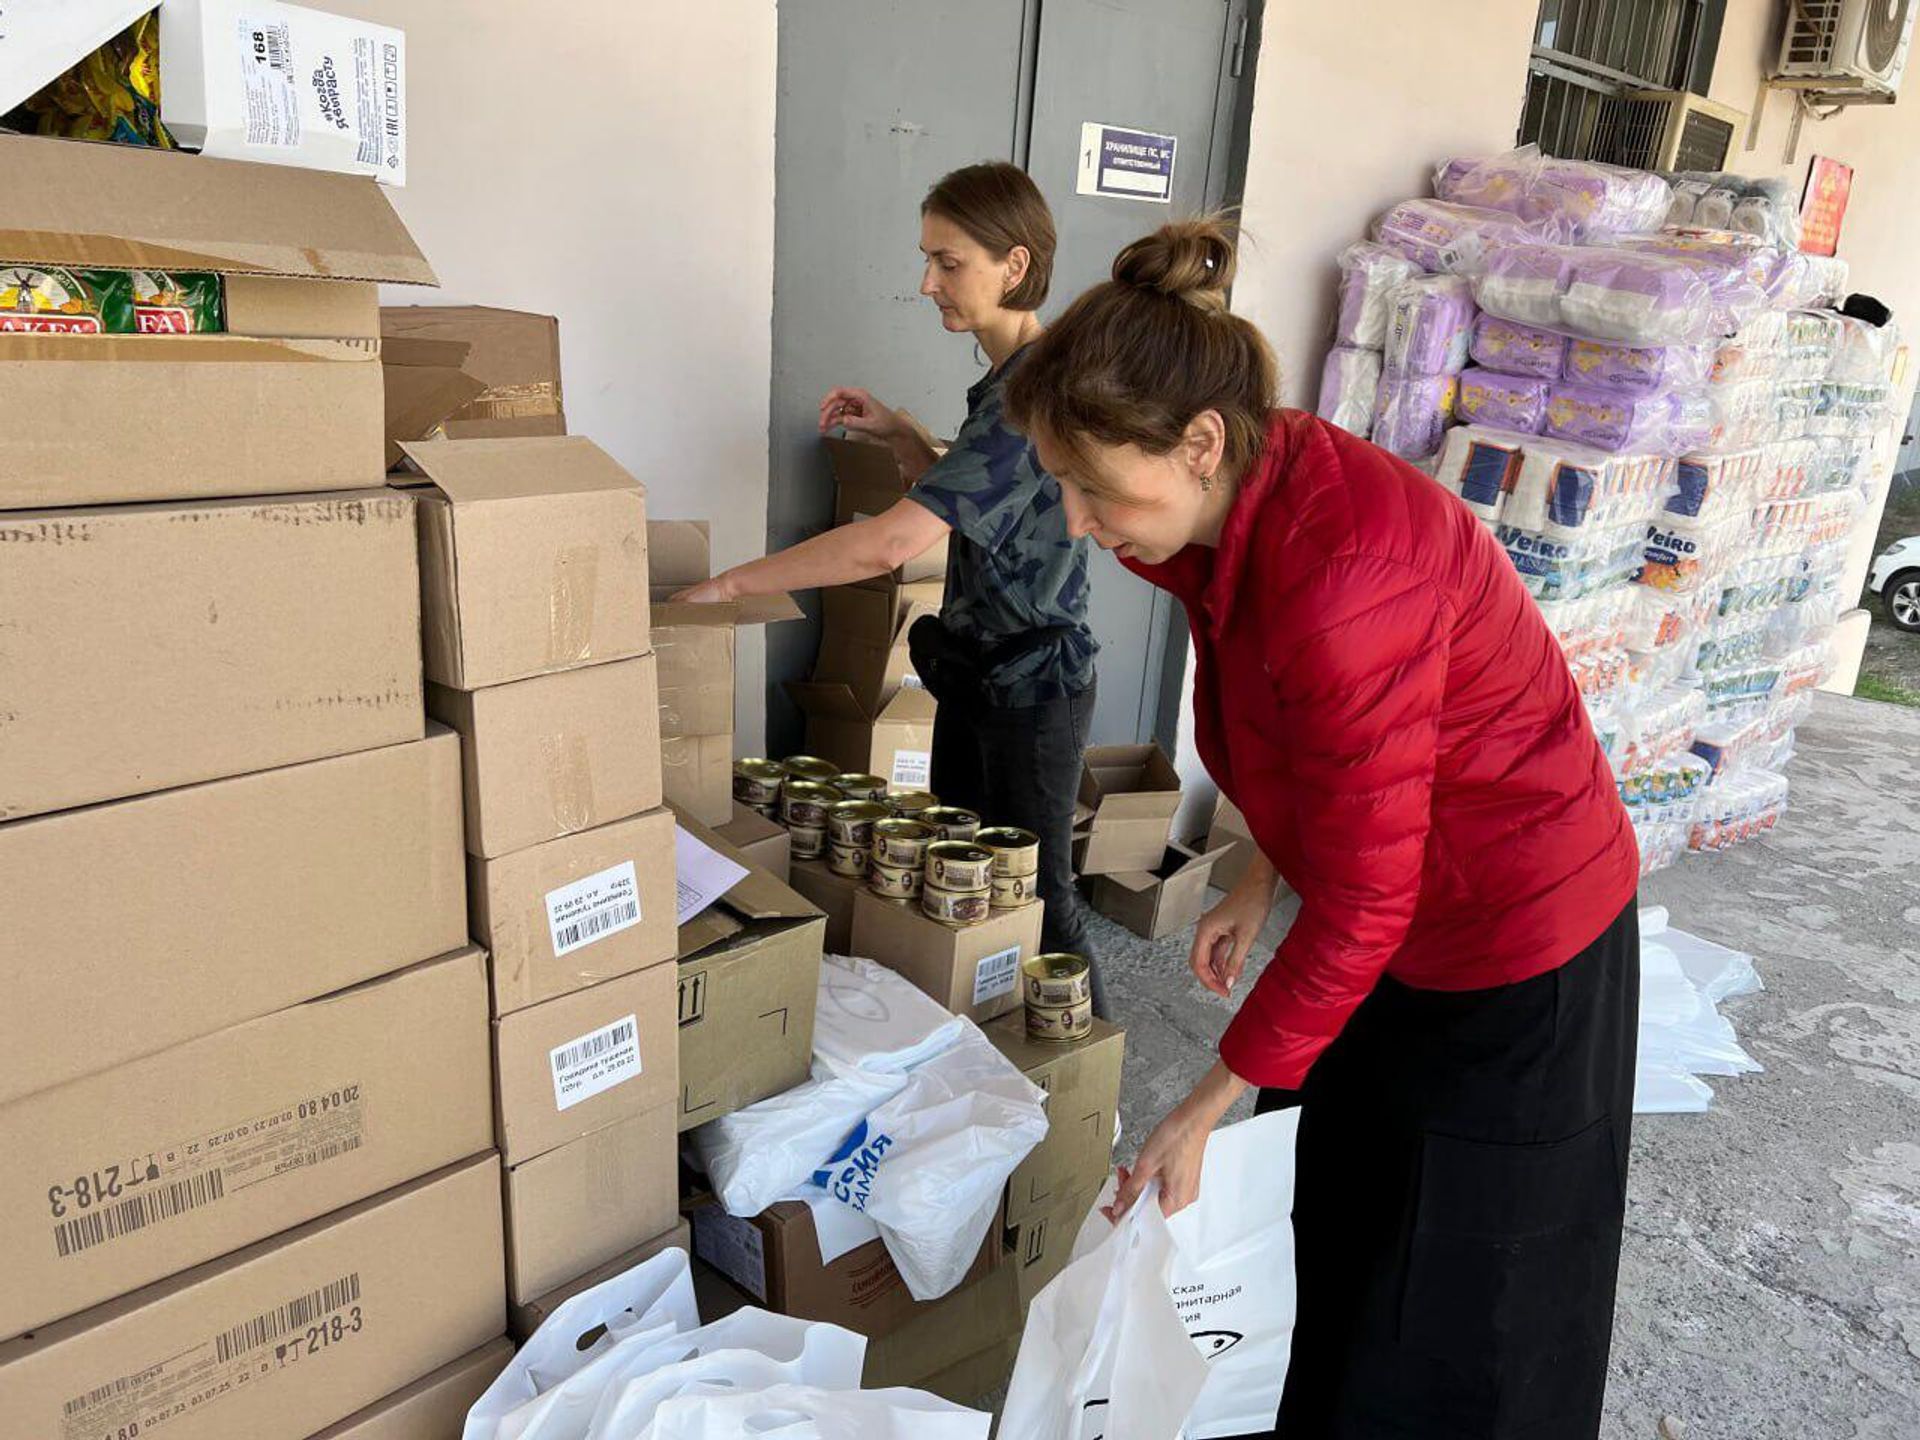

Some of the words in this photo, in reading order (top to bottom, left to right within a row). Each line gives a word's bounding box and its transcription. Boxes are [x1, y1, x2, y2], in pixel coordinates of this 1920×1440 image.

[252, 31, 267, 65] 168
[1084, 149, 1092, 169] 1
[48, 1165, 123, 1218] 218-3
[306, 1306, 363, 1355] 218-3
